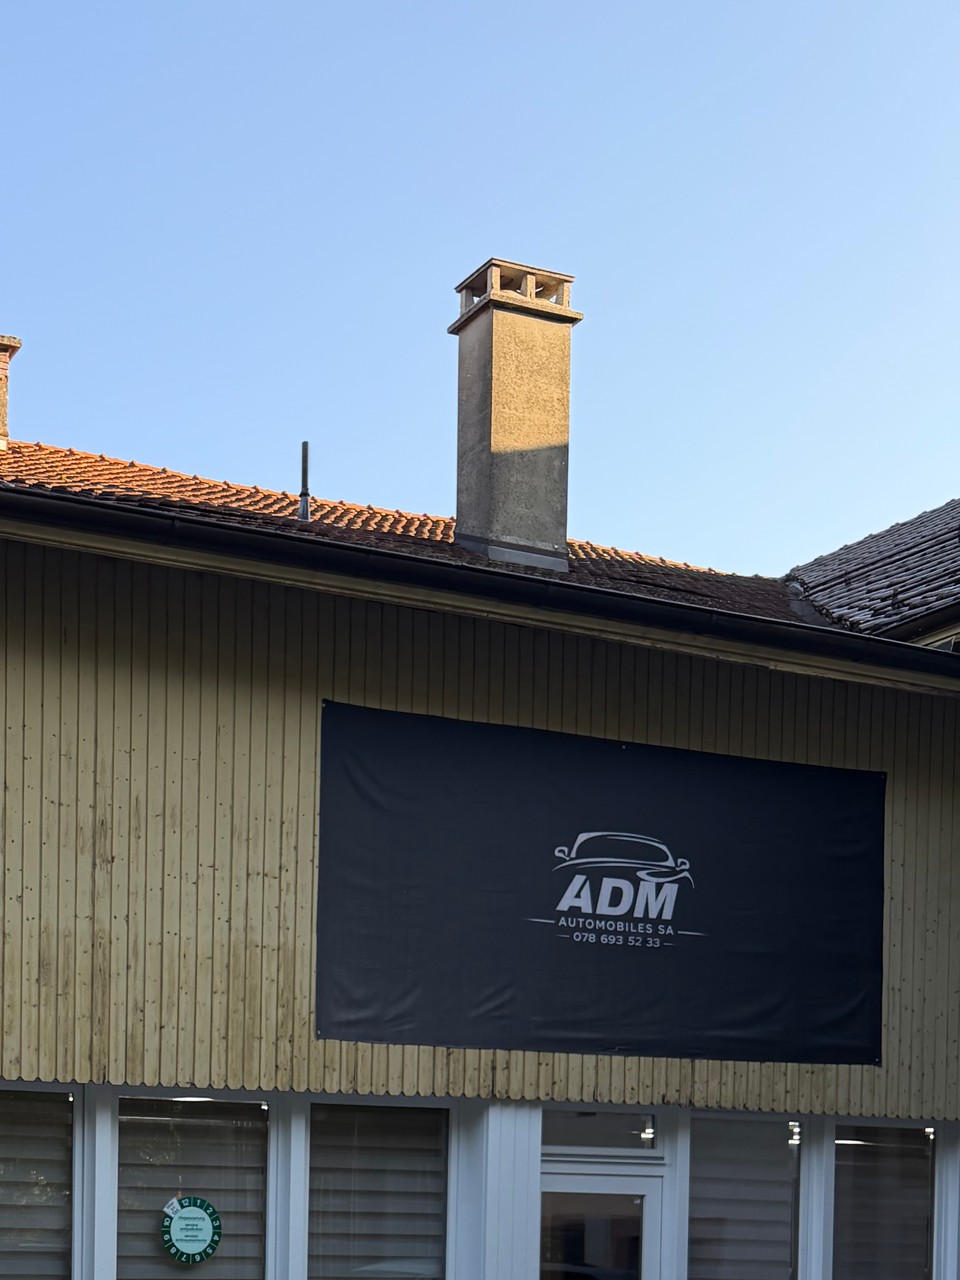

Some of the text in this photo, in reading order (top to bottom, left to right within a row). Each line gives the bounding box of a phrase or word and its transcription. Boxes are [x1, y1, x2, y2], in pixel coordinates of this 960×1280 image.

[556, 874, 678, 920] ADM
[558, 917, 674, 936] AUTOMOBILES SA
[573, 932, 660, 948] 078 693 52 33
